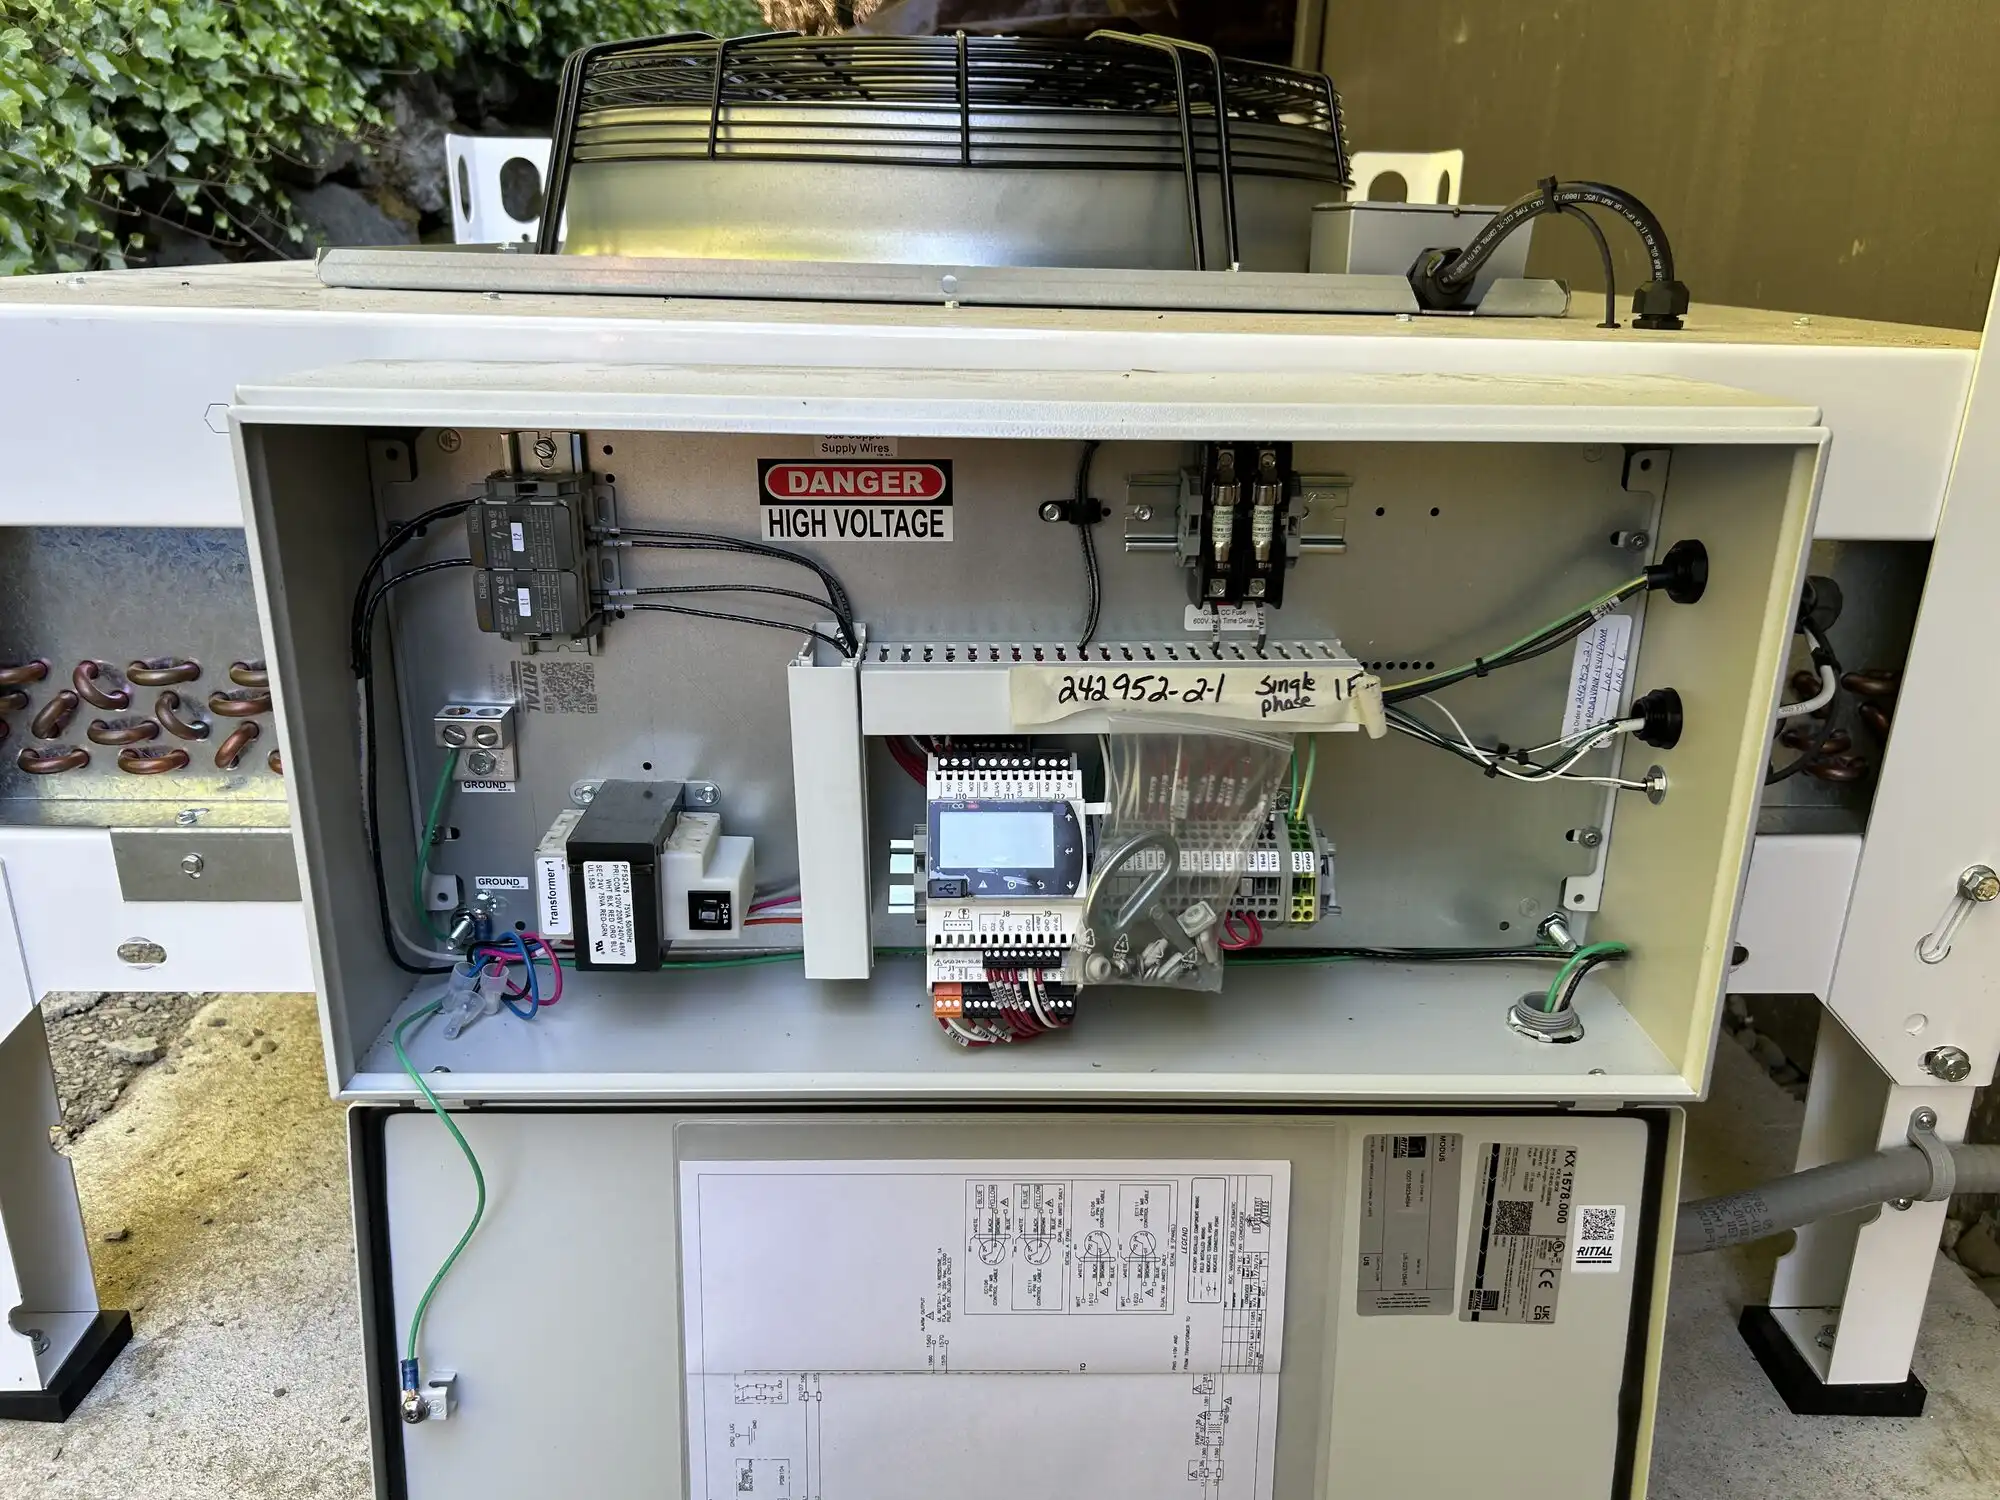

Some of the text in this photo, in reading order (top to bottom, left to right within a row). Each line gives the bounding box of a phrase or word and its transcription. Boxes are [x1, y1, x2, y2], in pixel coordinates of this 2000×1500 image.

[1515, 207, 1528, 217] TYPE
[1645, 235, 1655, 245] RES
[822, 443, 889, 454] Supply Wires
[787, 471, 924, 493] DANGER
[768, 509, 944, 537] HIGH VOLTAGE
[513, 533, 522, 541] L2
[520, 598, 528, 606] L1
[521, 662, 540, 712] RITTAL
[1255, 672, 1316, 700] Single
[1262, 695, 1316, 717] phase
[547, 868, 558, 926] Transformer
[1400, 1136, 1408, 1159] RITTAL
[1439, 1135, 1447, 1162] MODUS
[1557, 1150, 1576, 1224] KX 1578.000
[1363, 1256, 1371, 1267] US
[1577, 1246, 1613, 1256] RITTAL
[1475, 1289, 1483, 1311] RITTAL
[1080, 1363, 1086, 1371] TO
